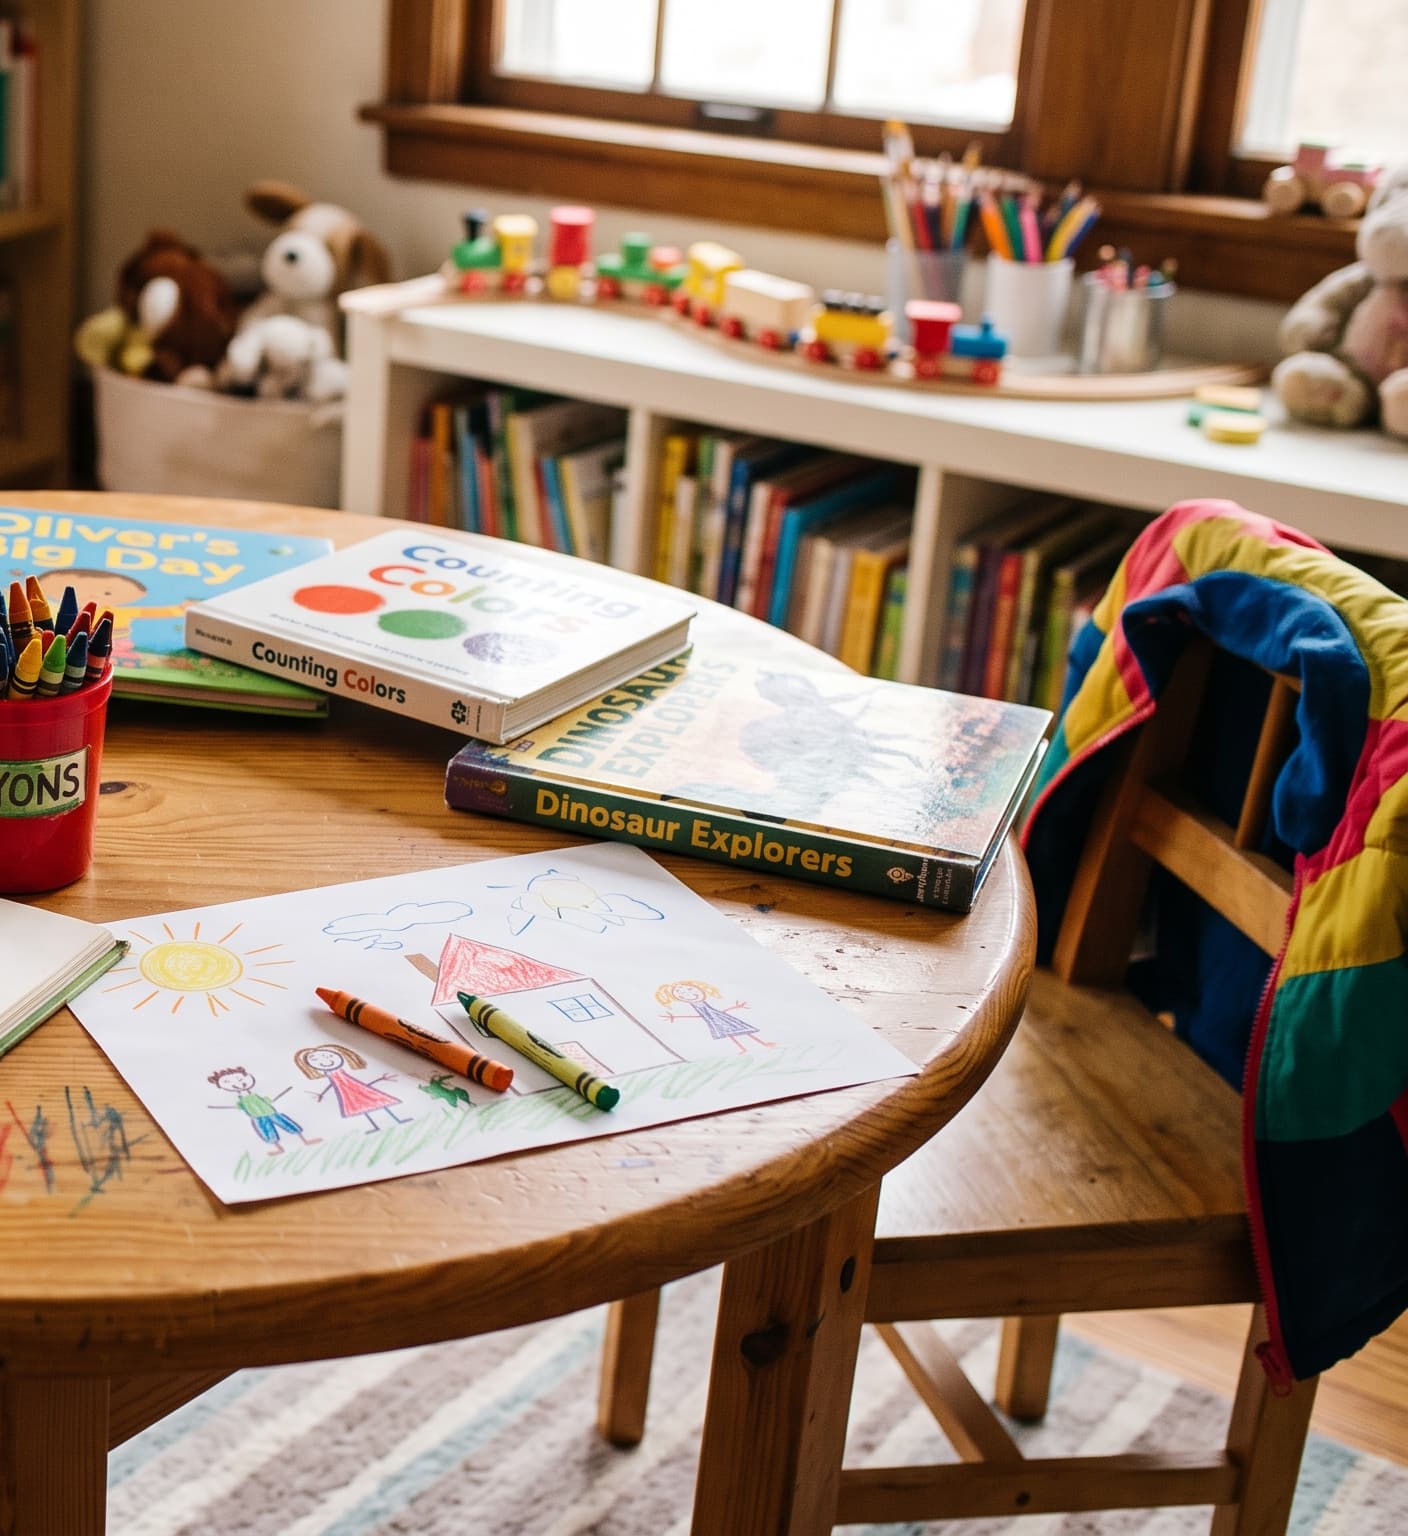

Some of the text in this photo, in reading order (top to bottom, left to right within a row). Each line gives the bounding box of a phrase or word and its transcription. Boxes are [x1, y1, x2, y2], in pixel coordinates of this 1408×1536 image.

[105, 547, 245, 585] Day
[368, 565, 590, 633] Colors
[402, 545, 641, 619] Counting
[252, 641, 338, 687] Counting
[344, 669, 406, 703] Colors
[535, 789, 853, 877] Dinosaur Explorers
